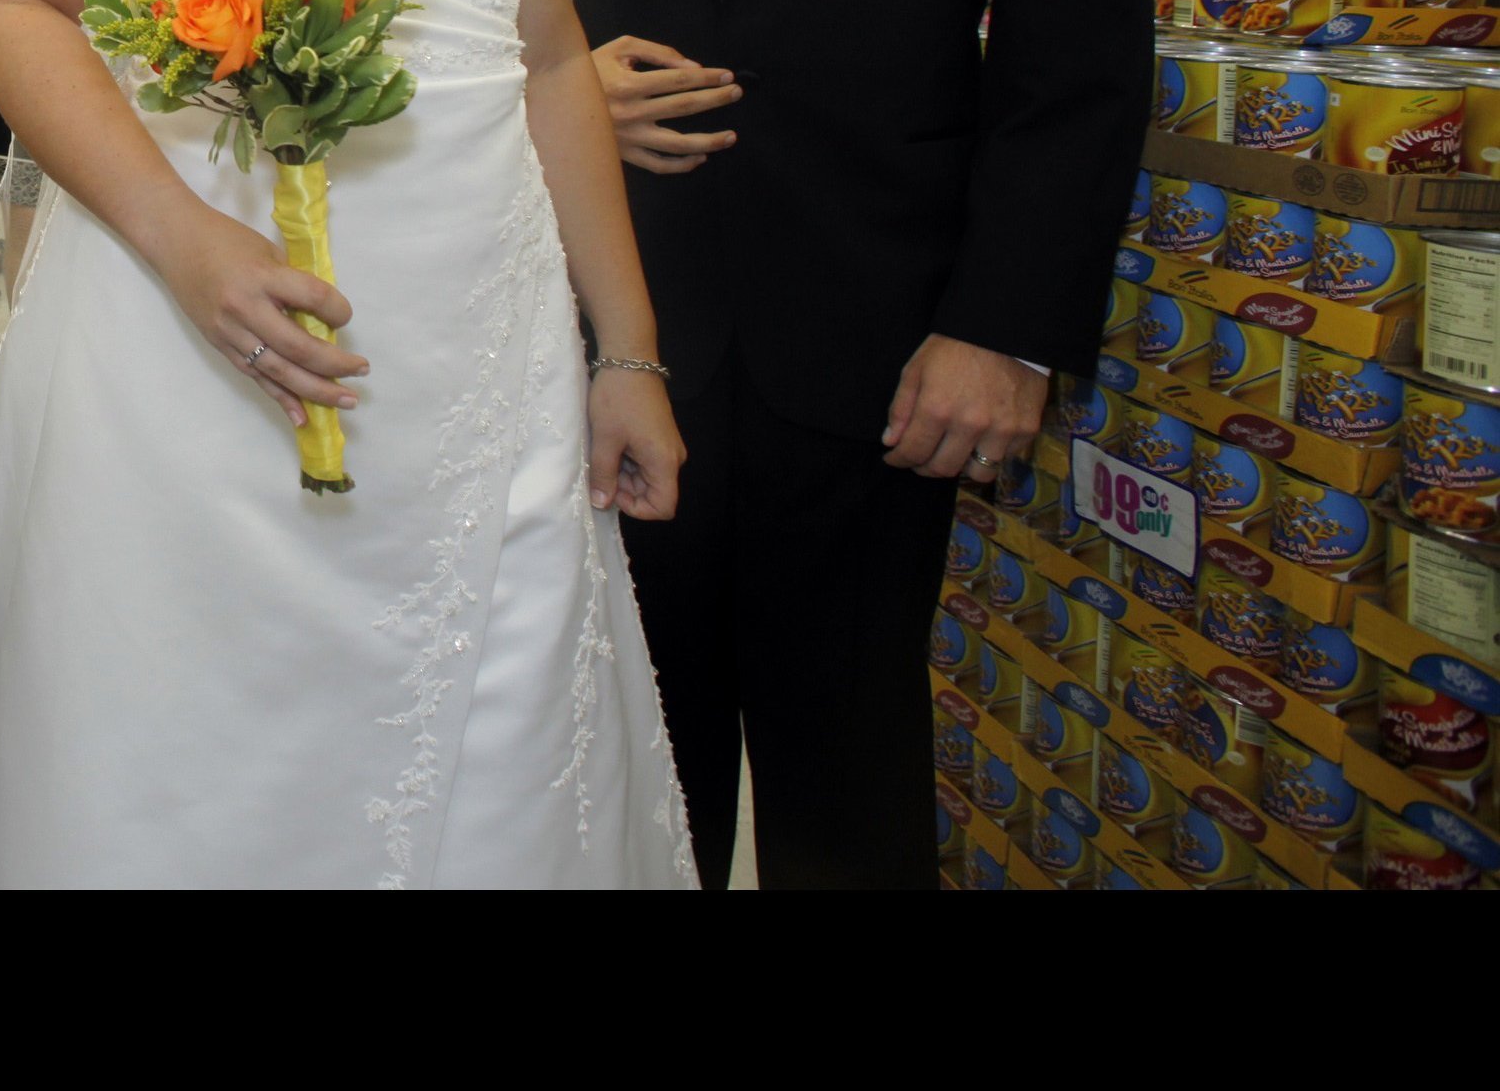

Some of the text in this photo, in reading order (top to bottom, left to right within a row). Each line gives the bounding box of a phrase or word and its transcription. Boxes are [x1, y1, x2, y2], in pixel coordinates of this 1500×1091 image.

[1385, 126, 1441, 152] Mini
[1093, 461, 1140, 535] 99
[1136, 510, 1173, 537] only
